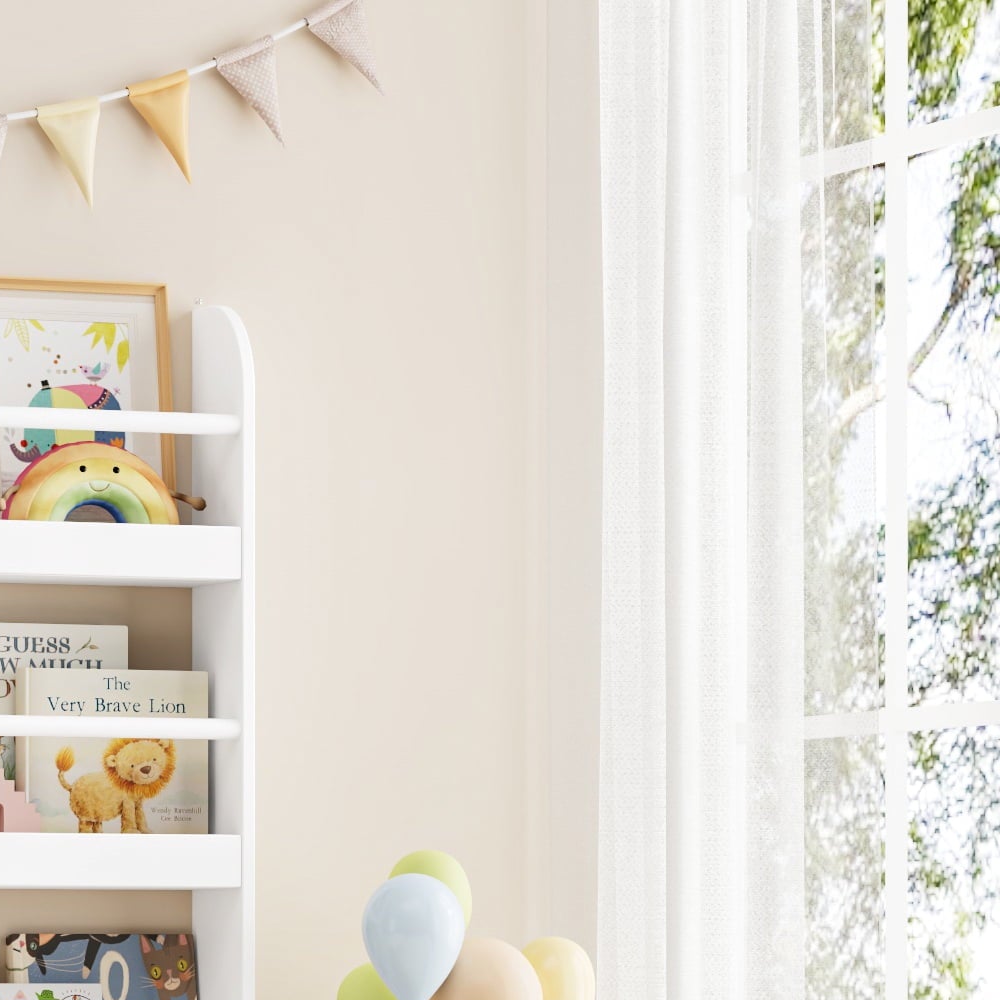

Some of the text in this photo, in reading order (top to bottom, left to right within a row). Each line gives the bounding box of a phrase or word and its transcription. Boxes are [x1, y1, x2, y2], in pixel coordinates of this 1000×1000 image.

[103, 676, 131, 691] The
[48, 696, 186, 716] Very Brave Lion
